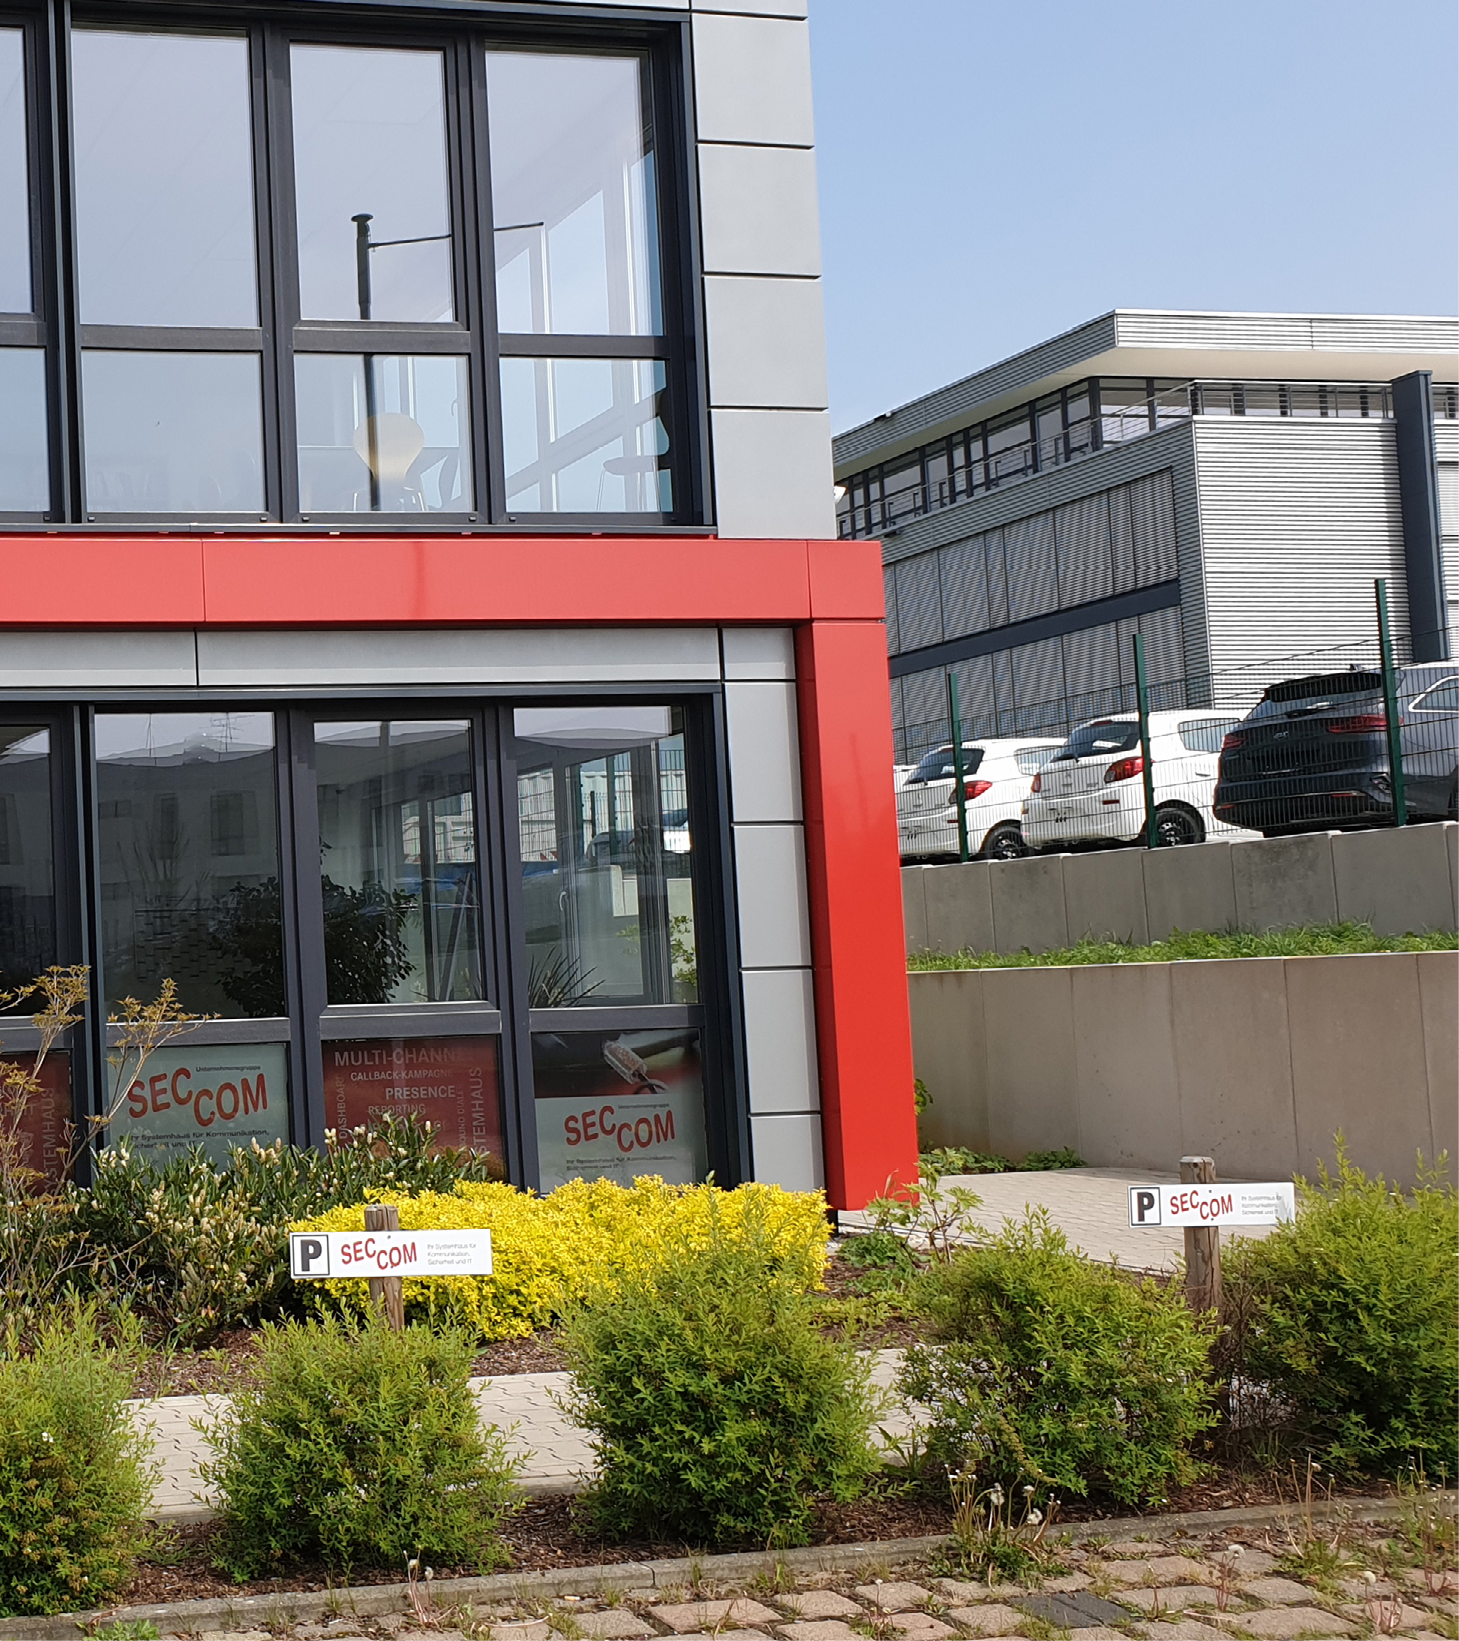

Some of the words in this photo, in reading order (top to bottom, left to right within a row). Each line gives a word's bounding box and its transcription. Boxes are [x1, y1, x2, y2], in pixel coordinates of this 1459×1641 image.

[195, 1065, 261, 1073] Unternehmensgruppe
[385, 1085, 456, 1100] PRESENCE
[141, 1133, 191, 1142] Systemhaus
[206, 1129, 270, 1138] Kommunikation,
[1137, 1191, 1155, 1222] P
[300, 1239, 322, 1272] P
